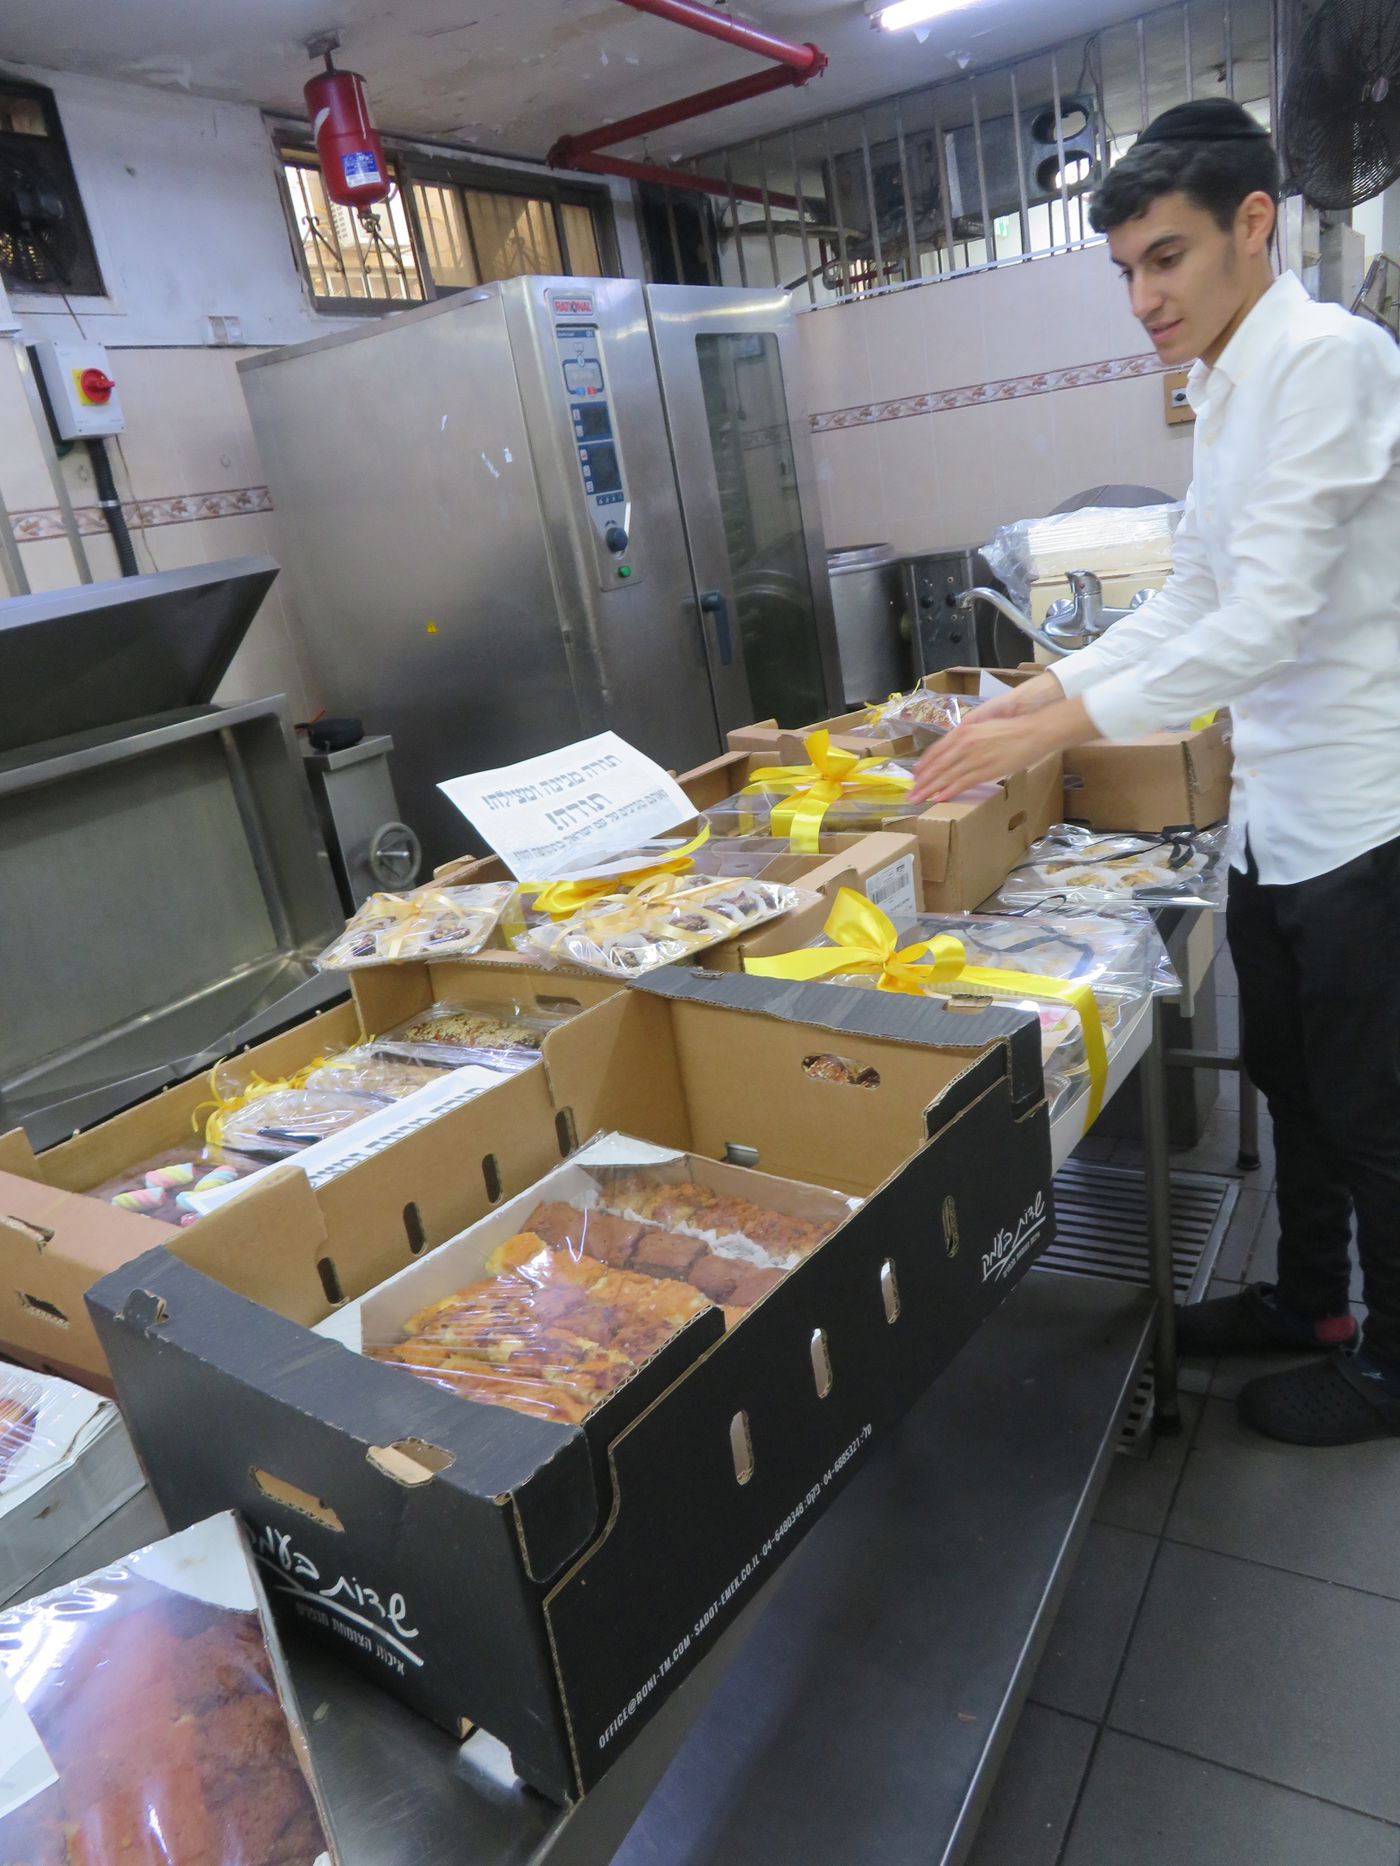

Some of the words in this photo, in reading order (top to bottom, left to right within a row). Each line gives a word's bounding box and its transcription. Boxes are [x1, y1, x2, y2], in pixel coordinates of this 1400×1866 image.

[581, 754, 622, 778] תורה
[539, 771, 586, 796] מגינה
[481, 784, 543, 811] ומצילה!
[562, 824, 593, 844] ישראל
[693, 1553, 761, 1637] SADOT-EMEK.CO.IL
[598, 1633, 692, 1750] OFFICE@RONI-TM.COM
